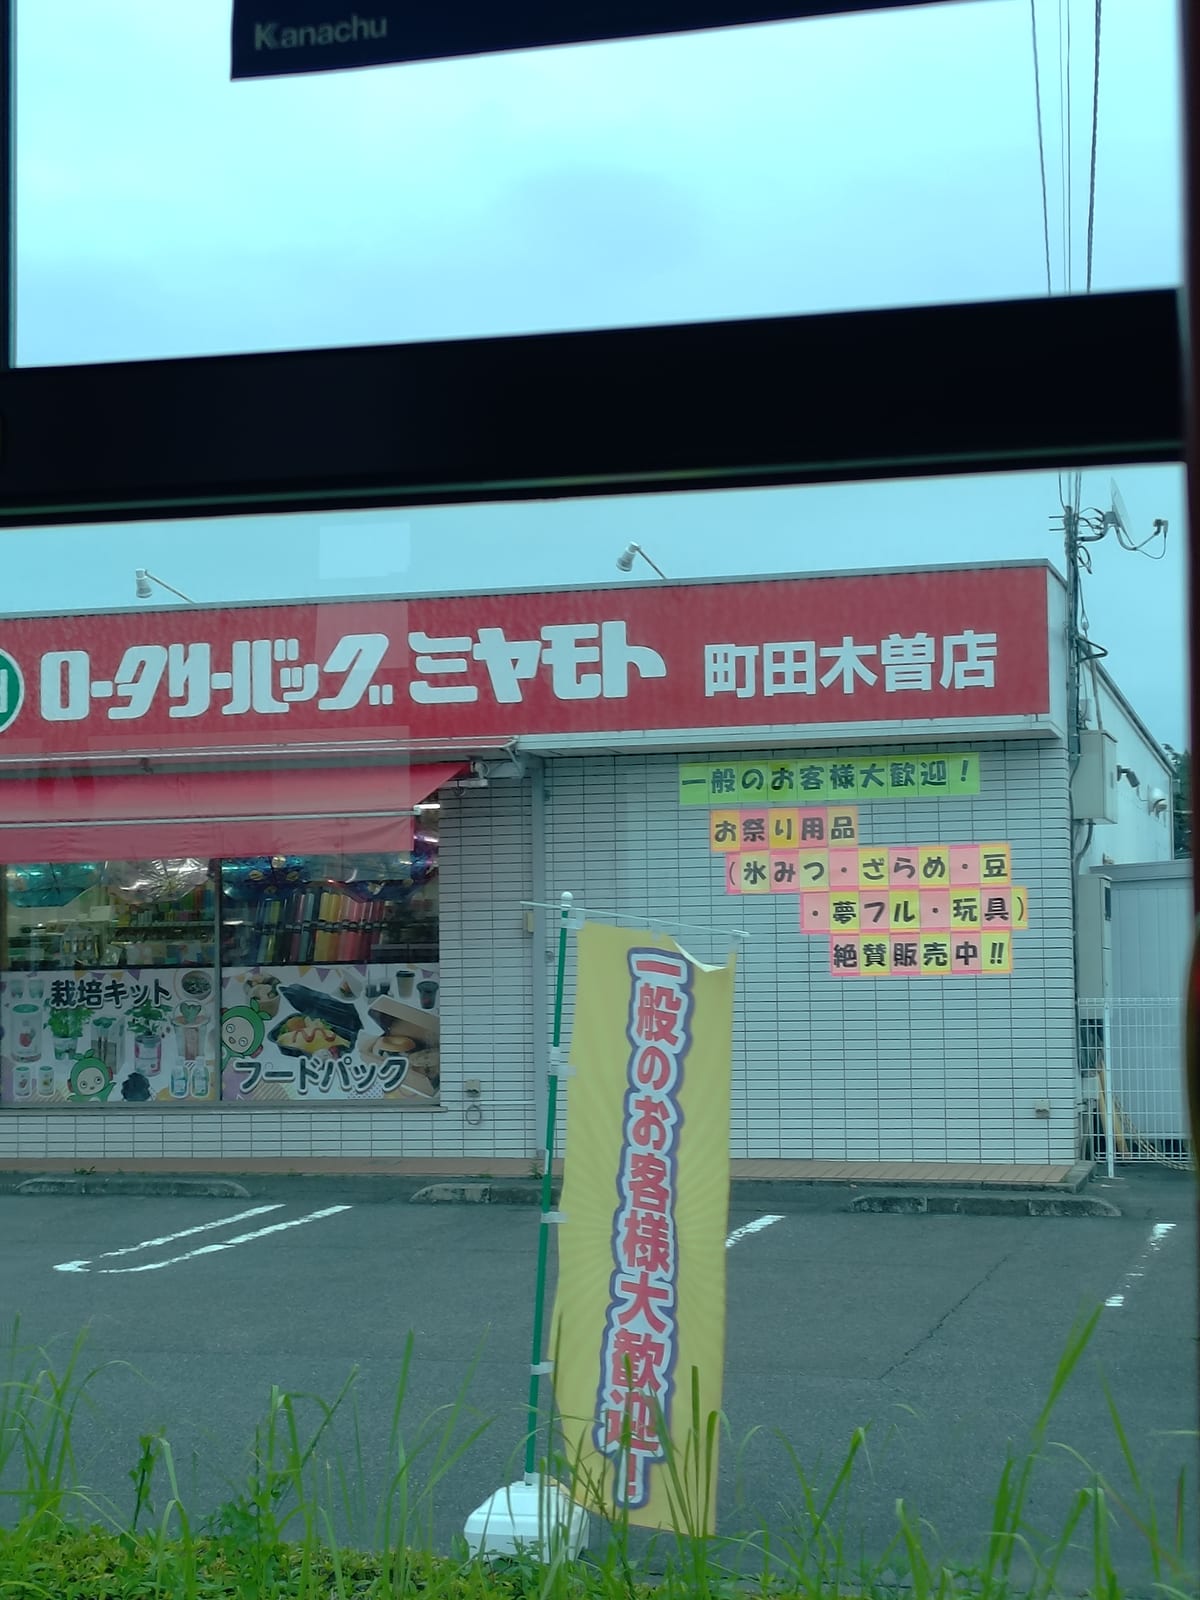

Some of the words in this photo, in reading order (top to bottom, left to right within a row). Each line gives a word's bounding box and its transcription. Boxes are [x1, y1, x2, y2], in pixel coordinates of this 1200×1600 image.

[254, 14, 388, 50] Kanachu
[407, 620, 668, 704] ミヤモト
[703, 629, 998, 698] 町田木曽店
[681, 758, 969, 794] 一般のお客様大歓迎！
[714, 815, 857, 843] お祭り用品
[832, 941, 1005, 969] 絶賛販売中!!
[50, 979, 171, 1008] 栽培キット
[234, 1056, 409, 1094] フードパック
